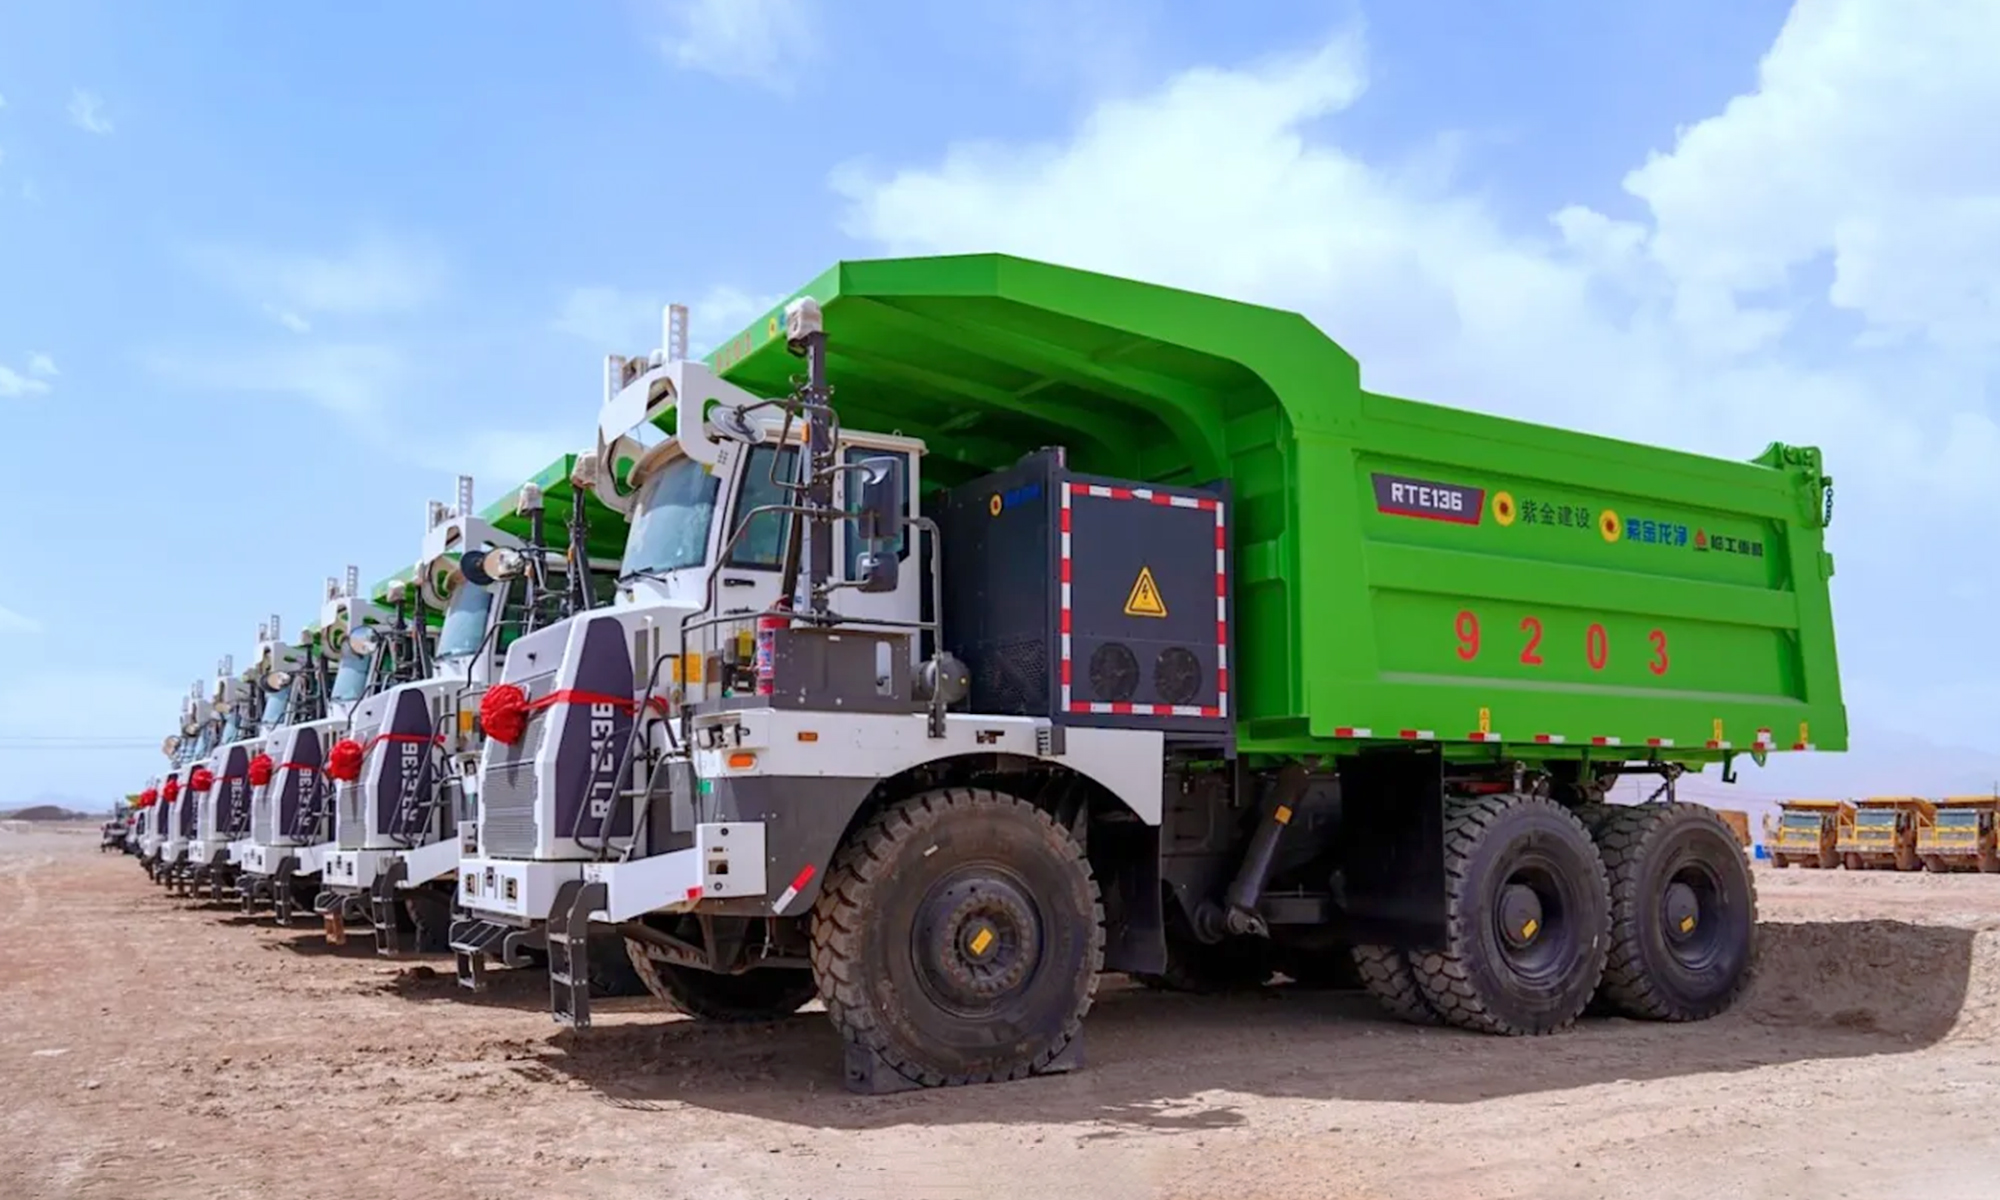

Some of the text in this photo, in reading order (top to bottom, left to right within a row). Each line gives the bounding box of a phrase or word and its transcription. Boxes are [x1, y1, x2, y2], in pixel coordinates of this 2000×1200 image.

[1391, 482, 1463, 511] RTE136
[1521, 499, 1590, 529] 紫金建设
[1626, 517, 1688, 547] 紫金龙净
